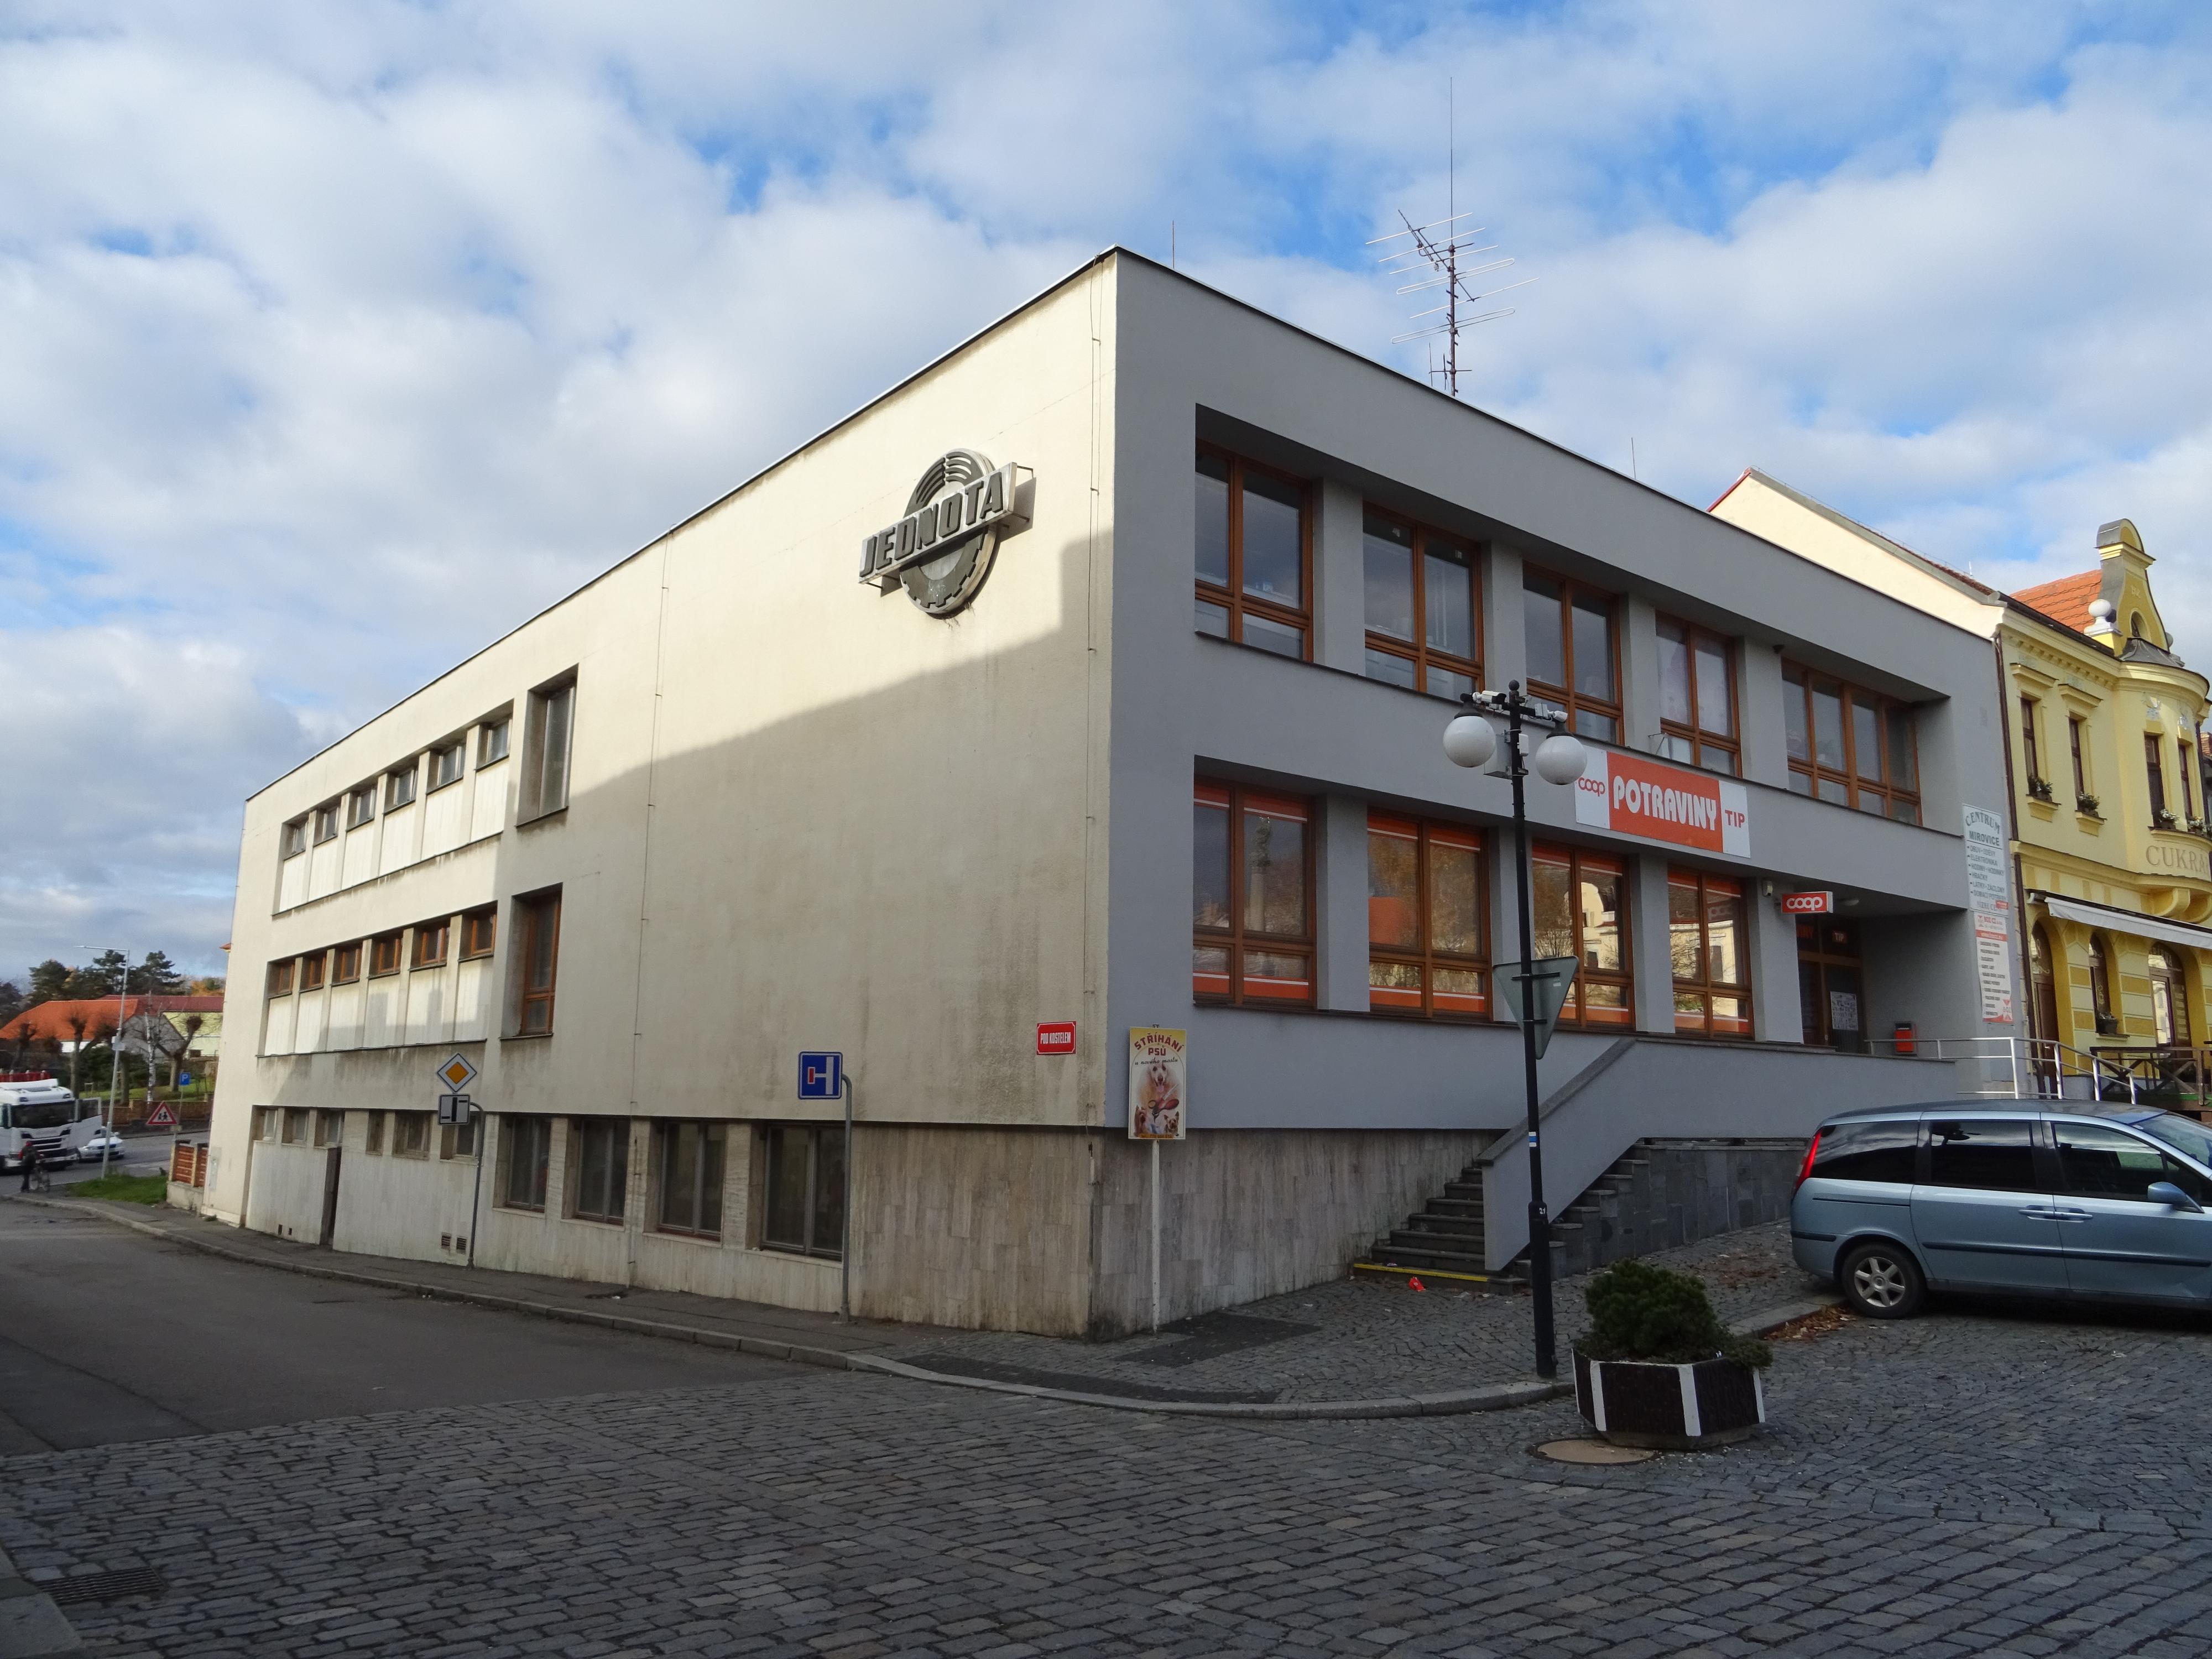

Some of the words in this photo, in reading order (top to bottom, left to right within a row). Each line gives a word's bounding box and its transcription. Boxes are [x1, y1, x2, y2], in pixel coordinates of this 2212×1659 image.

[859, 471, 1004, 577] JEDNOTA
[1578, 777, 1605, 797] coop
[1613, 775, 1717, 831] POTRAVINY
[1724, 809, 1746, 828] TIP
[1965, 811, 2000, 834] CENTRUM
[1969, 831, 2000, 846] MIROVICE
[1786, 896, 1823, 911] coop
[1040, 1032, 1048, 1045] POD
[1049, 1031, 1071, 1044] KOSTELEM
[1134, 1032, 1185, 1052] STŘÍHÁNÍ
[1148, 1045, 1166, 1056] PSŮ
